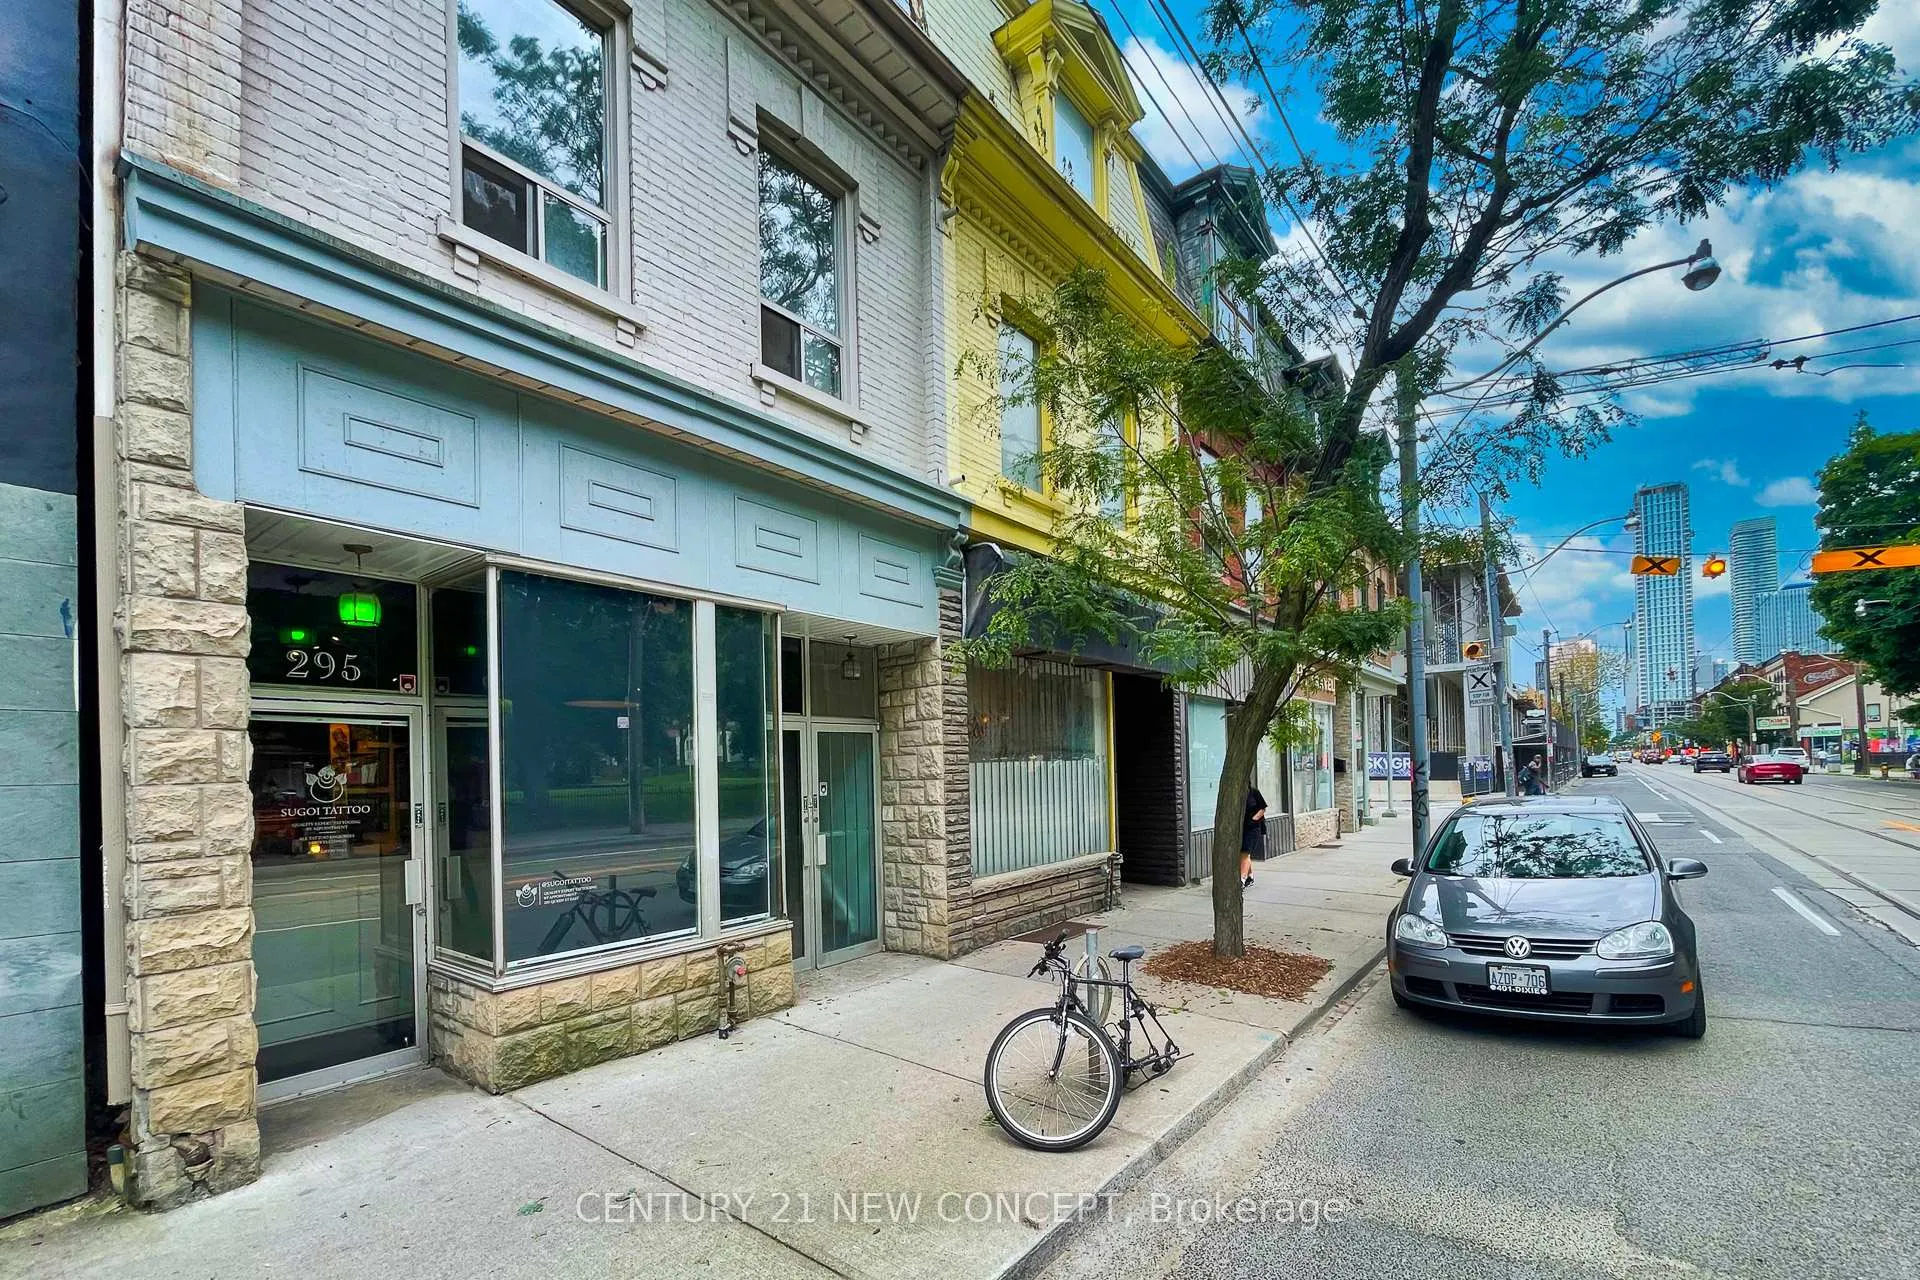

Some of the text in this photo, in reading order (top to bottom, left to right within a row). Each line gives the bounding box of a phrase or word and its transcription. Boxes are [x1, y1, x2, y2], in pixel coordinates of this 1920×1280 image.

[286, 650, 361, 681] 295
[281, 805, 371, 817] SUGOI TATTOO
[1496, 985, 1540, 994] 401-DIXIE
